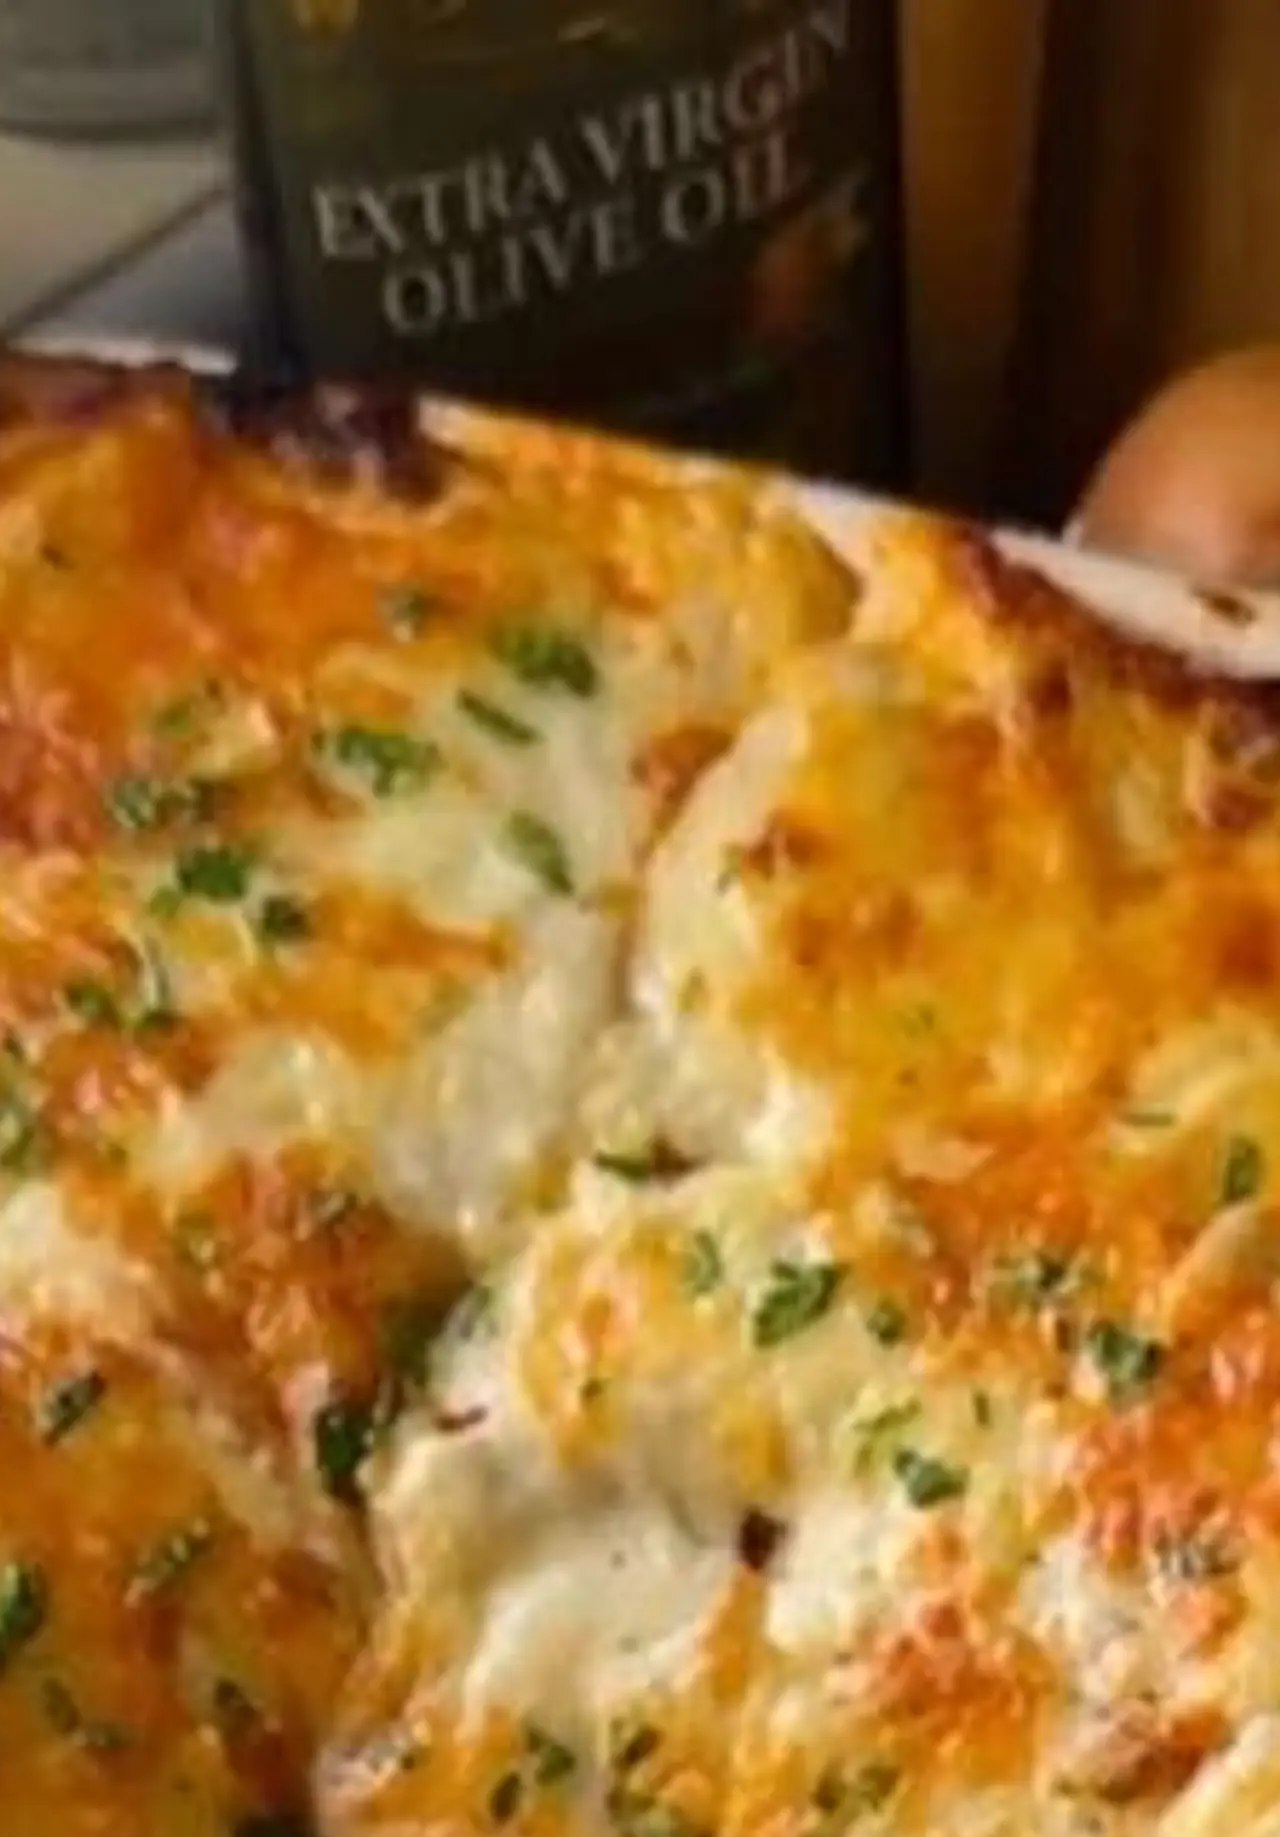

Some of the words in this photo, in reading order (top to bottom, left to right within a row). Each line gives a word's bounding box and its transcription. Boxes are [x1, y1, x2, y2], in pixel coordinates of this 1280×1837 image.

[314, 138, 567, 260] EXTRA
[580, 5, 847, 184] VIRGIN
[383, 205, 642, 336] OLIVE
[661, 134, 806, 245] OIL
